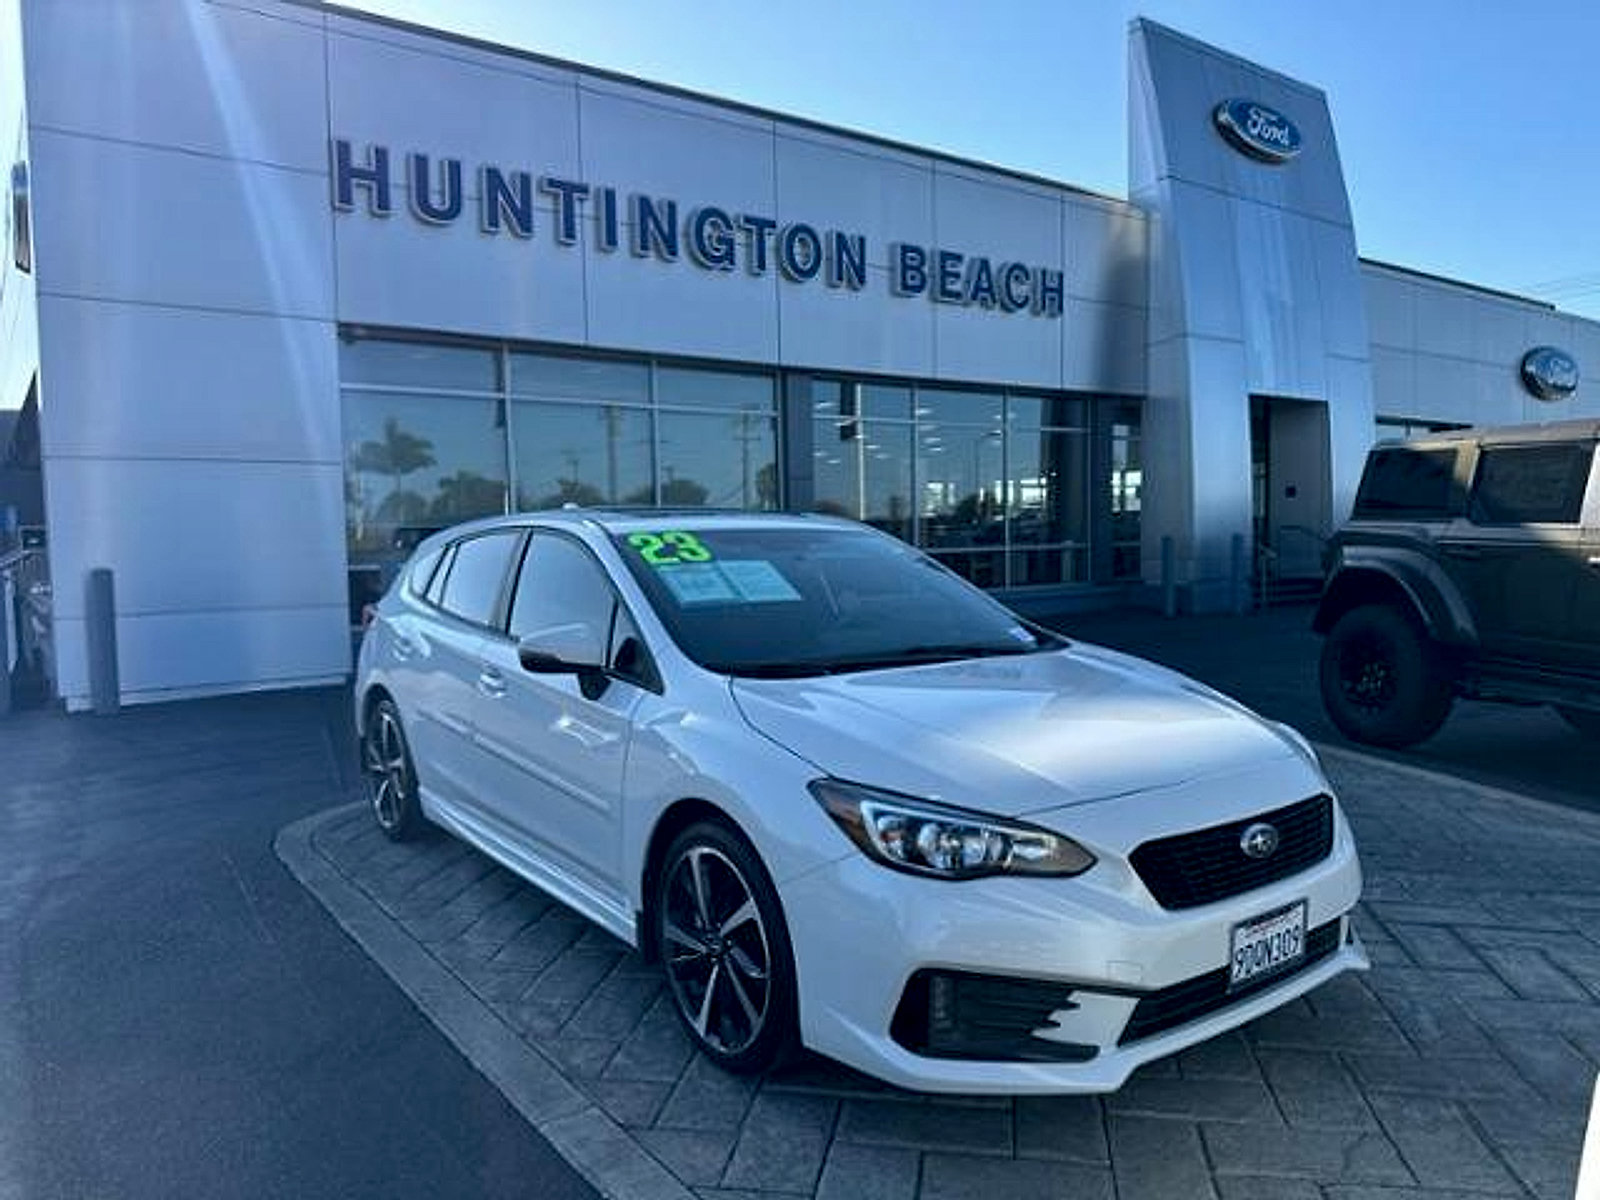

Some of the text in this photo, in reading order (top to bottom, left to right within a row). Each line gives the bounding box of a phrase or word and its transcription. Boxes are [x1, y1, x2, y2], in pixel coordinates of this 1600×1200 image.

[1247, 107, 1289, 146] Ford
[332, 139, 1065, 318] HUNTINGTON BEACH
[627, 529, 713, 566] 23
